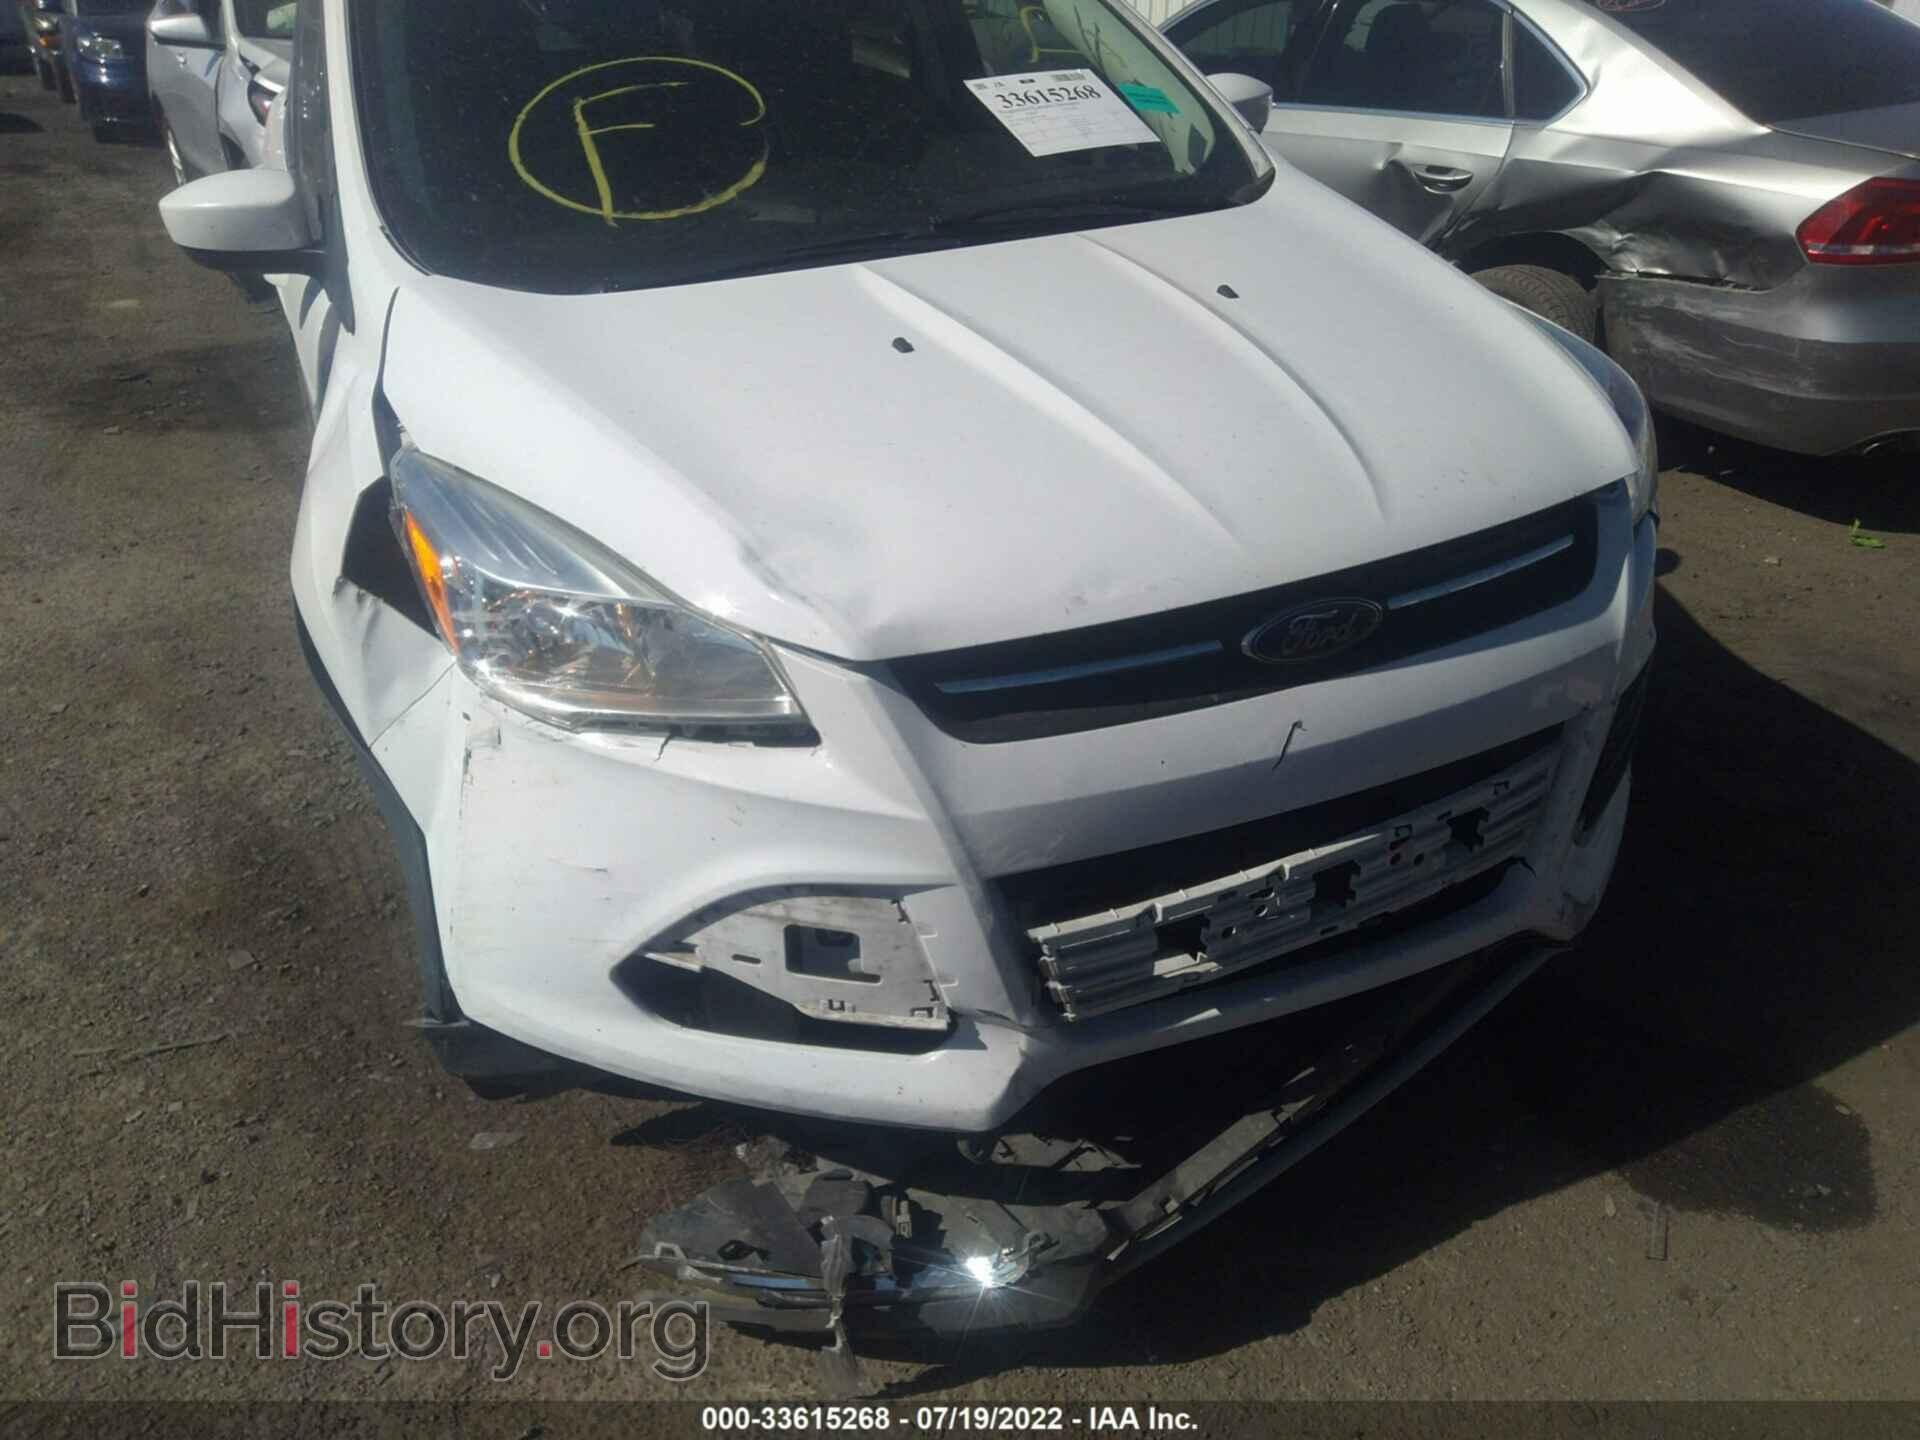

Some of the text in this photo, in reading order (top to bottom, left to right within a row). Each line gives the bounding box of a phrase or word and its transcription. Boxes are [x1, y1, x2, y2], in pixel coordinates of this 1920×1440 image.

[993, 84, 1102, 109] 33615268
[573, 81, 690, 228] F
[1281, 609, 1371, 656] Ford
